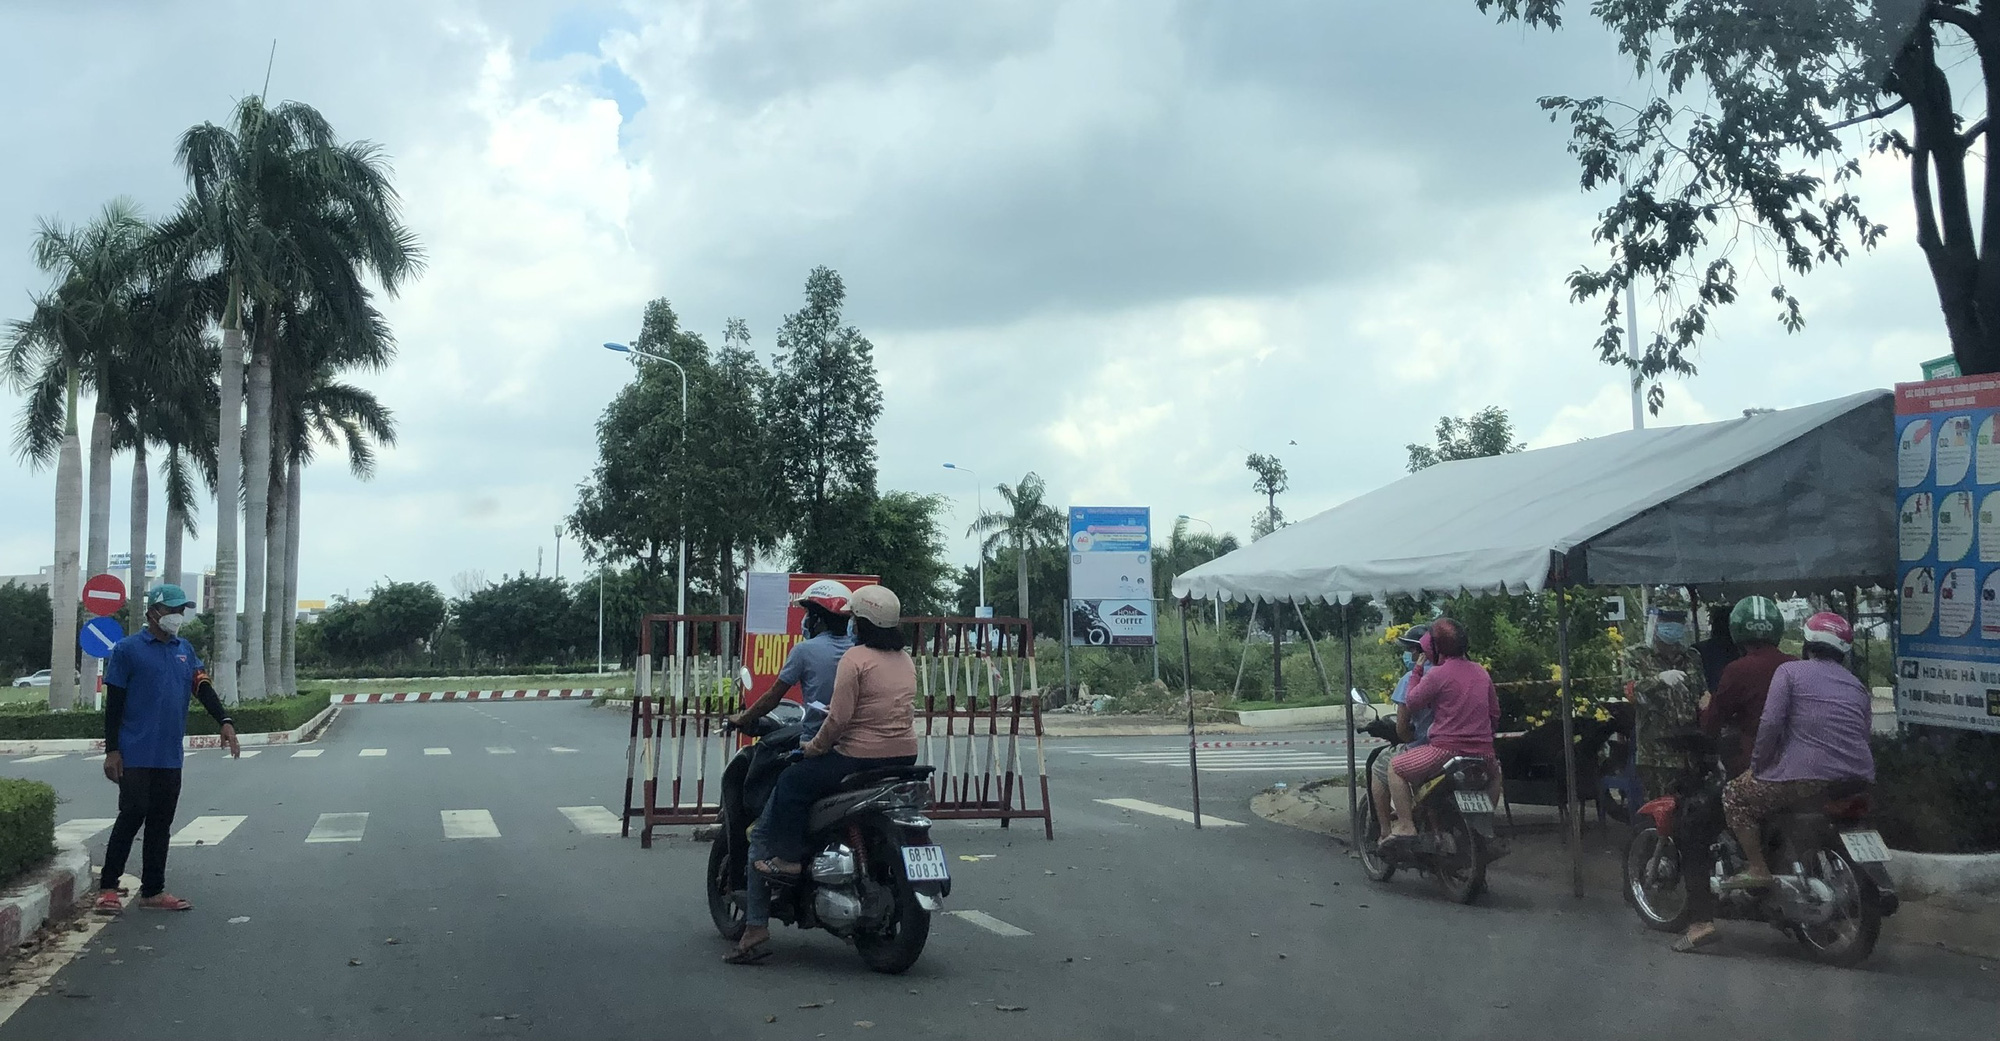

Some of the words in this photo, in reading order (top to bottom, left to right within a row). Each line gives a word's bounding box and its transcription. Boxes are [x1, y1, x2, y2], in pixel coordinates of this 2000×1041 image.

[1115, 617, 1143, 625] COFFEE
[1745, 620, 1774, 631] Grab
[1922, 665, 1958, 681] HOÀNG
[908, 846, 938, 862] 68-D1
[908, 862, 946, 878] 608.31
